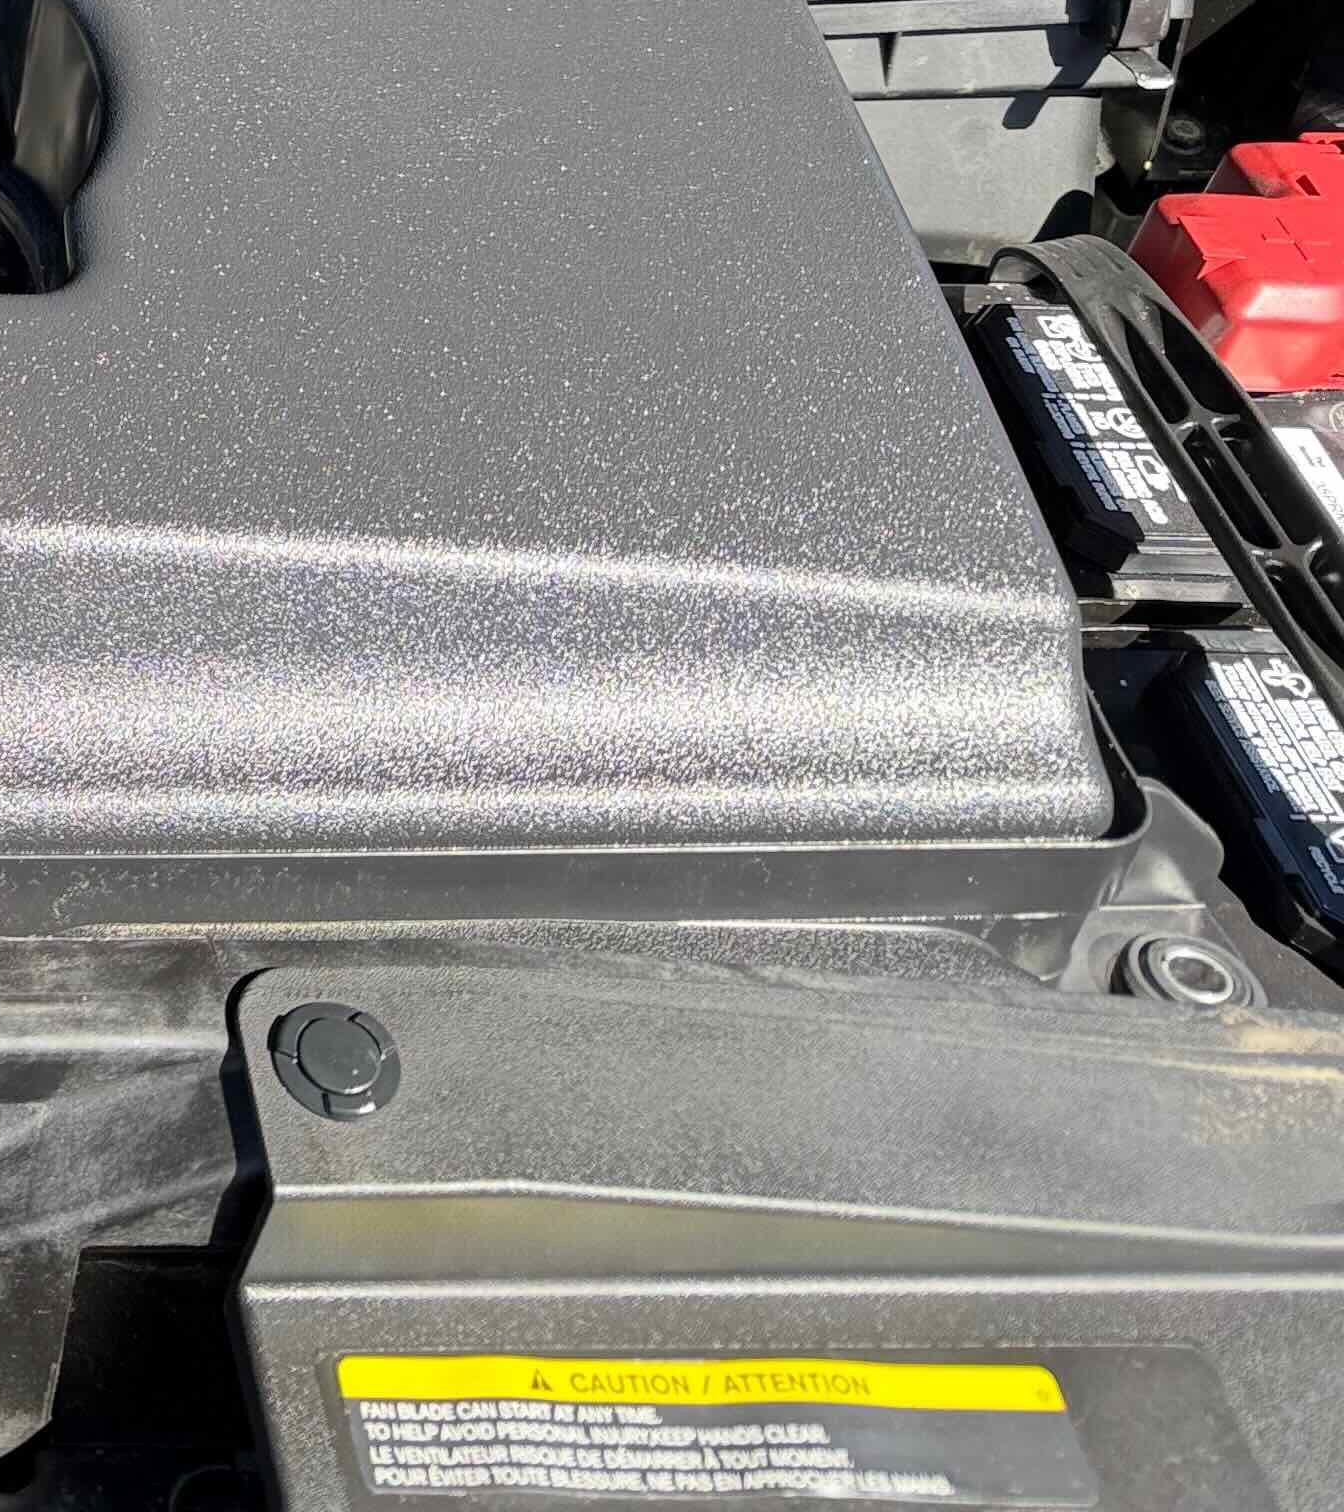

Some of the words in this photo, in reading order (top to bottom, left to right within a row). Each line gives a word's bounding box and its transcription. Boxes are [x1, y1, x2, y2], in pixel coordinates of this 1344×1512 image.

[569, 1372, 691, 1395] CAUTION
[724, 1372, 872, 1395] ATTENTION
[360, 1401, 396, 1420] FAN
[397, 1402, 456, 1421] BLADE
[456, 1402, 497, 1420] CAN
[498, 1402, 552, 1422] START
[578, 1406, 615, 1424] ANY
[364, 1422, 391, 1441] TO
[392, 1423, 440, 1442] HELP
[440, 1423, 496, 1442] AVOID
[497, 1423, 590, 1445] PERSONAL
[369, 1445, 394, 1465] LE
[395, 1445, 509, 1465] VENTILATEUR
[576, 1448, 603, 1468] DE
[720, 1449, 768, 1469] TOUT
[373, 1466, 428, 1486] POUR
[492, 1467, 550, 1487] TOUTE
